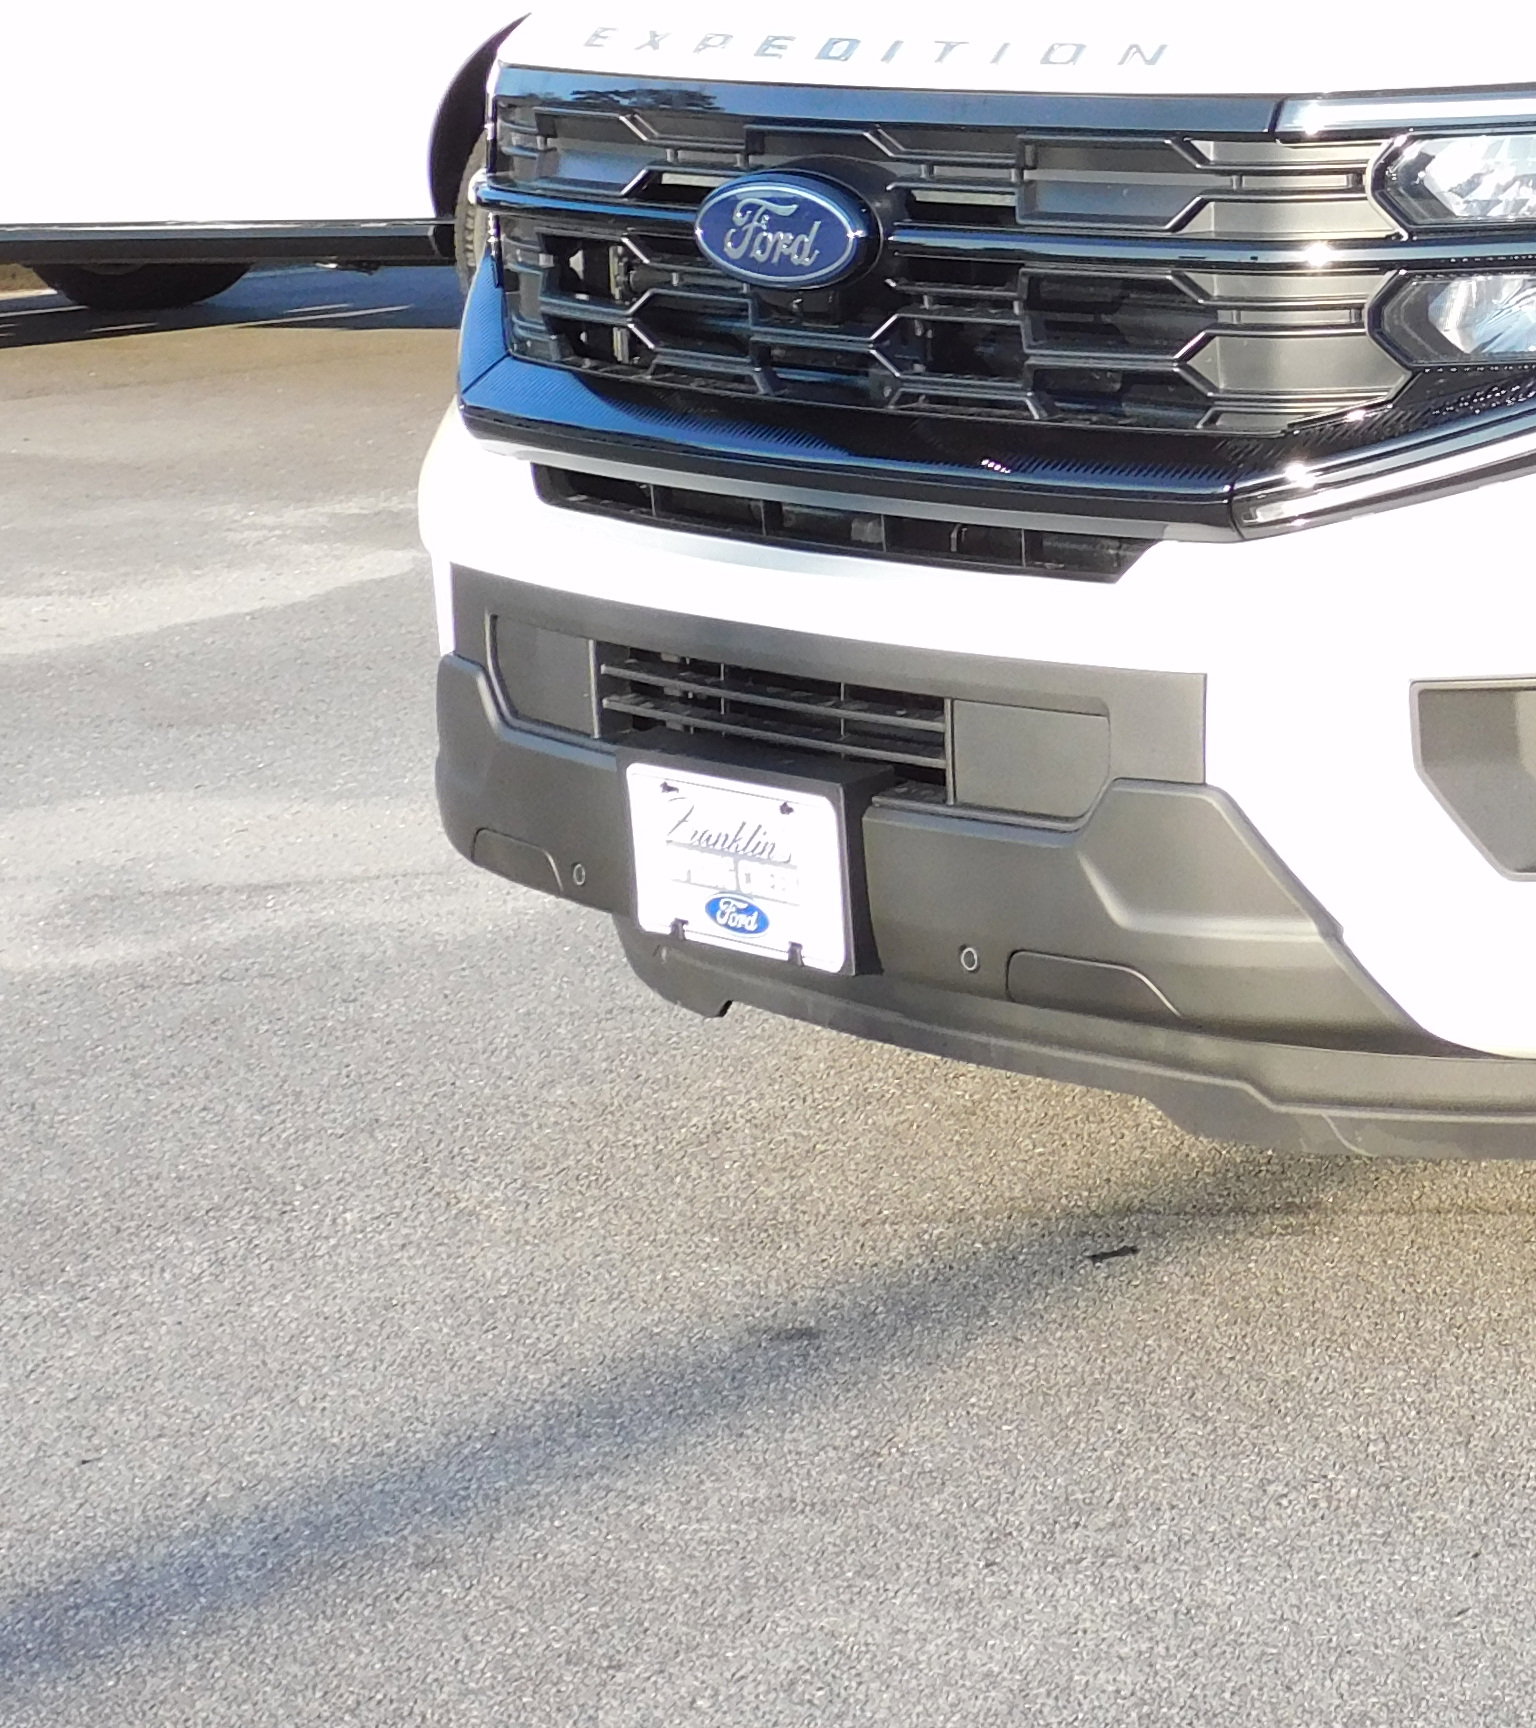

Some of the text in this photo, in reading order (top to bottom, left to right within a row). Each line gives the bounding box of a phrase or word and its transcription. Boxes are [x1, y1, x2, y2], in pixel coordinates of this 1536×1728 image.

[584, 26, 1168, 66] EXPEDITION
[724, 199, 821, 268] Ford
[667, 797, 792, 863] Franklin
[717, 899, 759, 930] Ford
